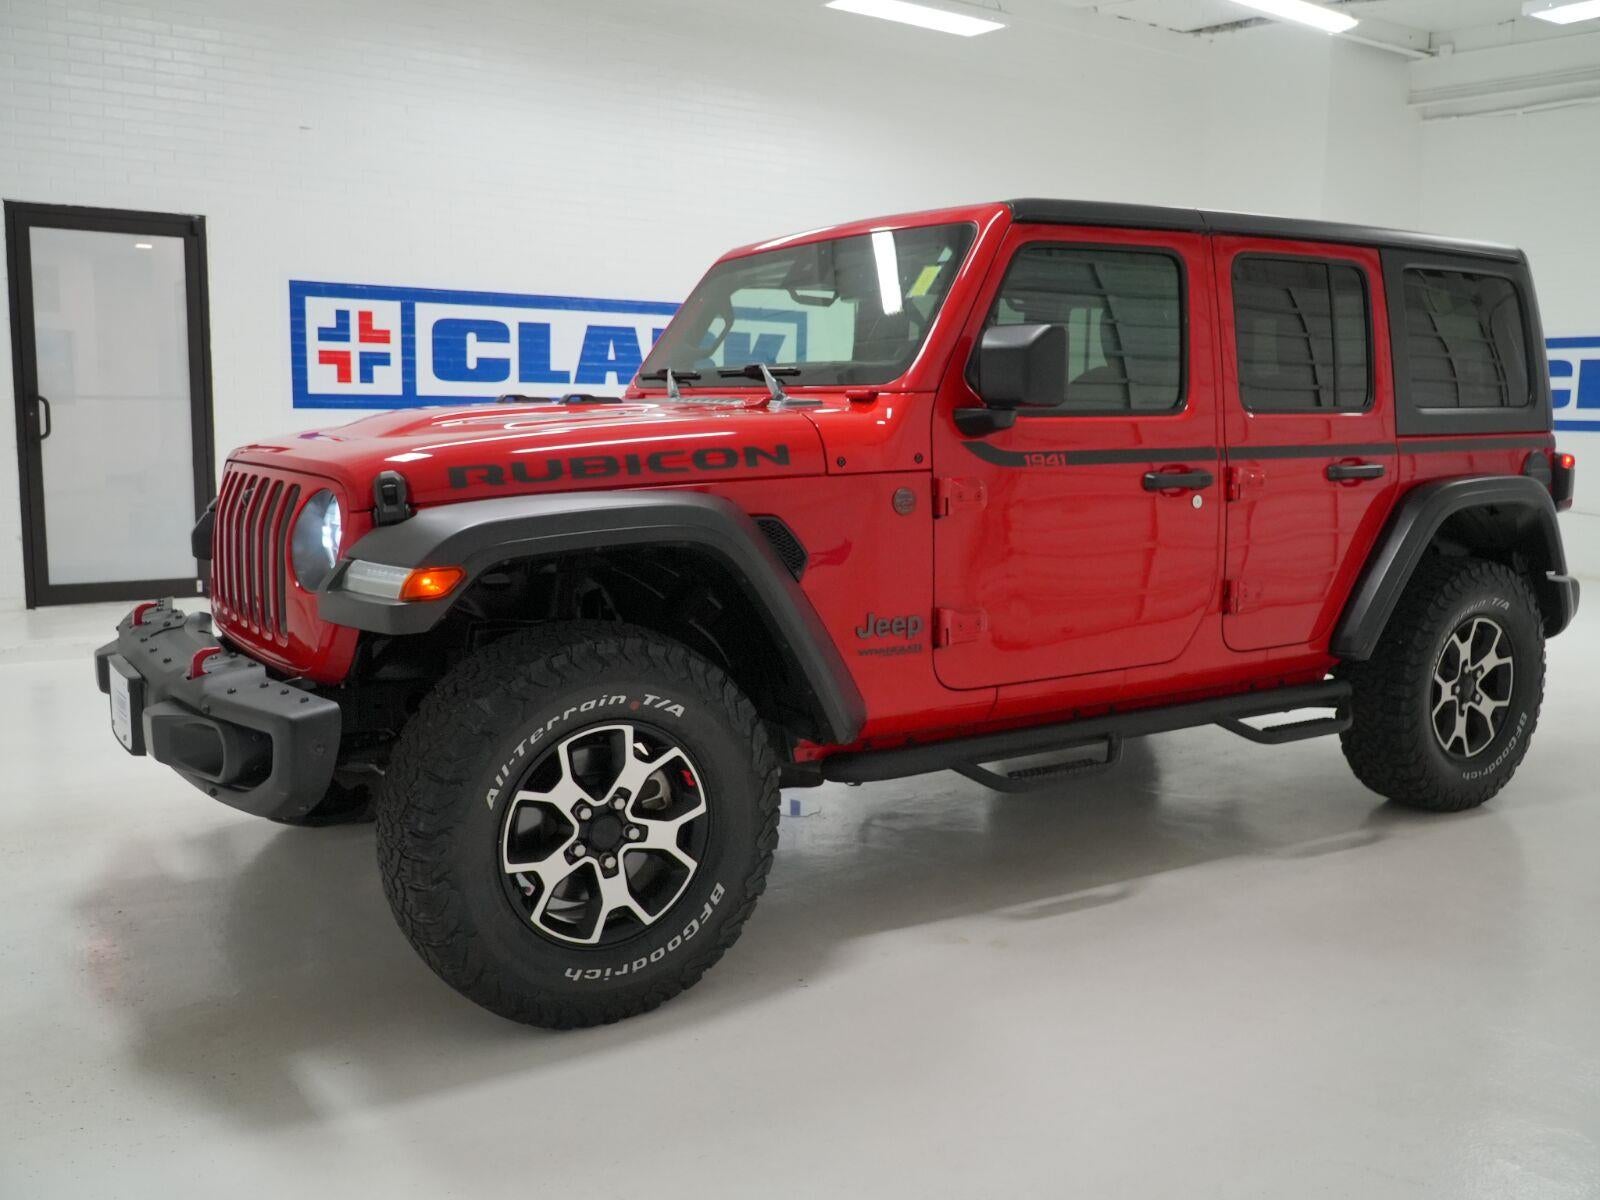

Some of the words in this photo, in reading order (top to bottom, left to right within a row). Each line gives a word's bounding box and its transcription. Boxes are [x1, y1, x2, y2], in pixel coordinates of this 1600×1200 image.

[432, 318, 787, 386] CLAK
[448, 444, 790, 489] RUBICON
[1023, 453, 1066, 466] 1941
[855, 612, 922, 640] Jeep
[486, 694, 627, 810] All-Terrain
[640, 693, 687, 719] T/A
[1462, 711, 1527, 780] BFGoodrich
[564, 882, 725, 982] BFGoodrich
